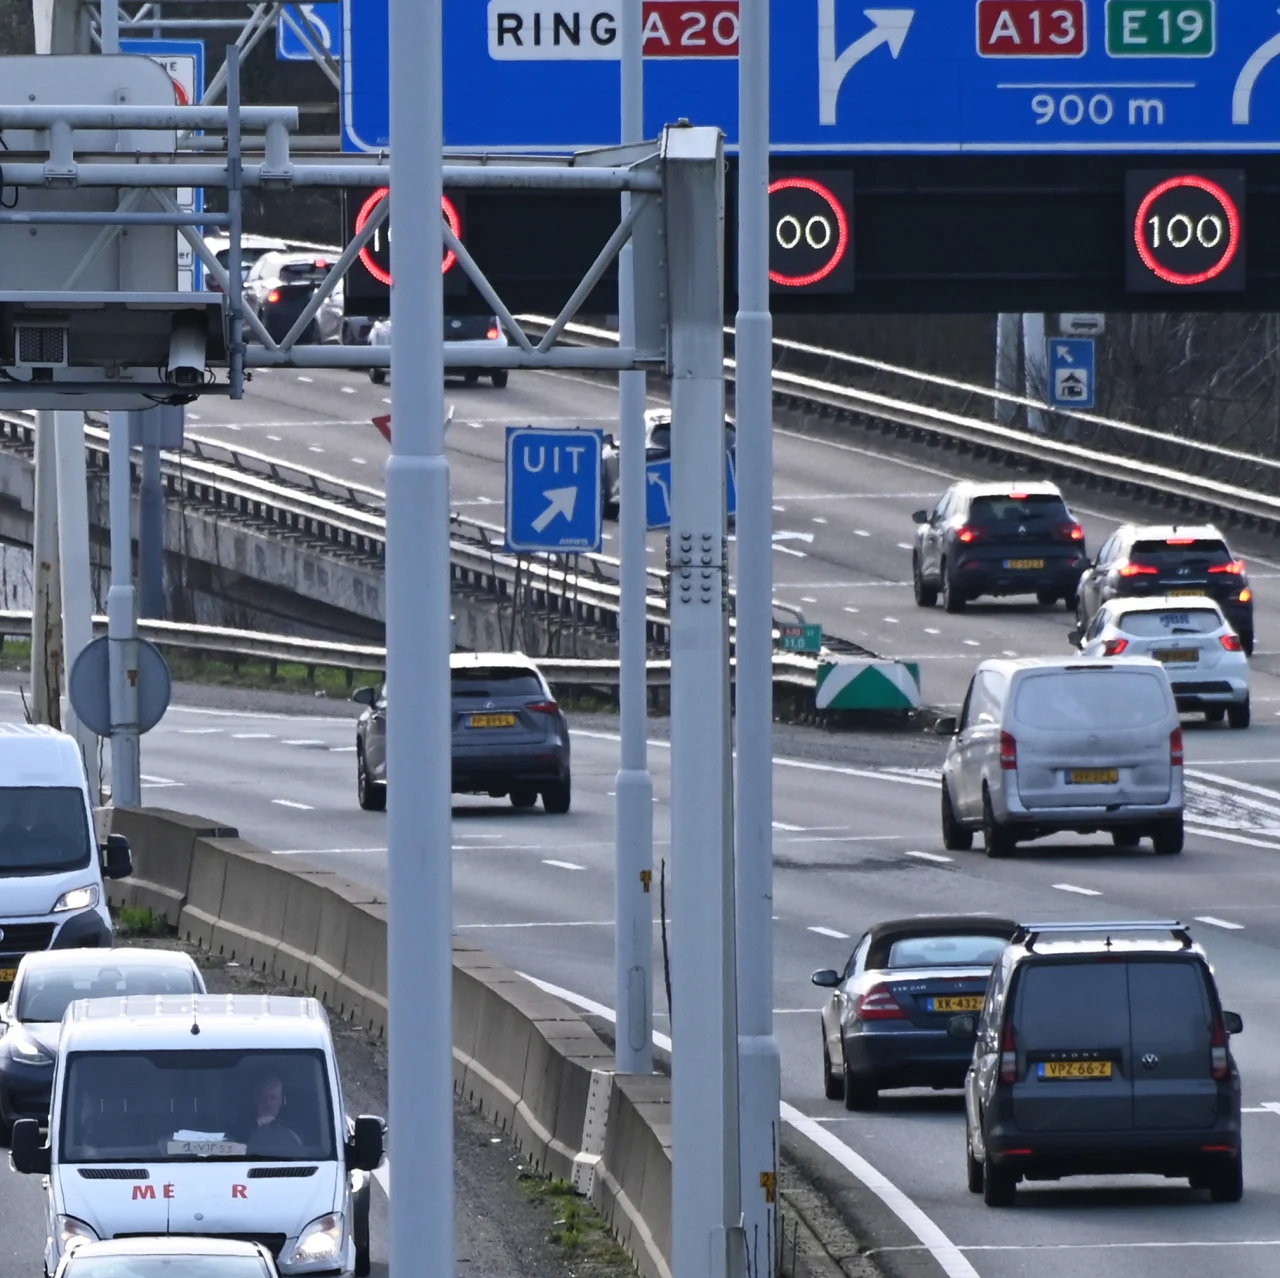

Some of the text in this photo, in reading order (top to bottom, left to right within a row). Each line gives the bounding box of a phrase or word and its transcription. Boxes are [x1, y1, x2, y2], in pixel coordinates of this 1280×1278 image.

[497, 11, 739, 46] RING A20
[988, 10, 1076, 45] A13
[1122, 10, 1203, 45] E19
[159, 62, 177, 72] NE
[1031, 94, 1164, 125] 900 m
[776, 214, 831, 249] 00
[1148, 213, 1222, 248] 100
[523, 446, 586, 474] UIT
[937, 997, 983, 1009] XK-432-
[1049, 1063, 1106, 1075] VPZ-66-Z
